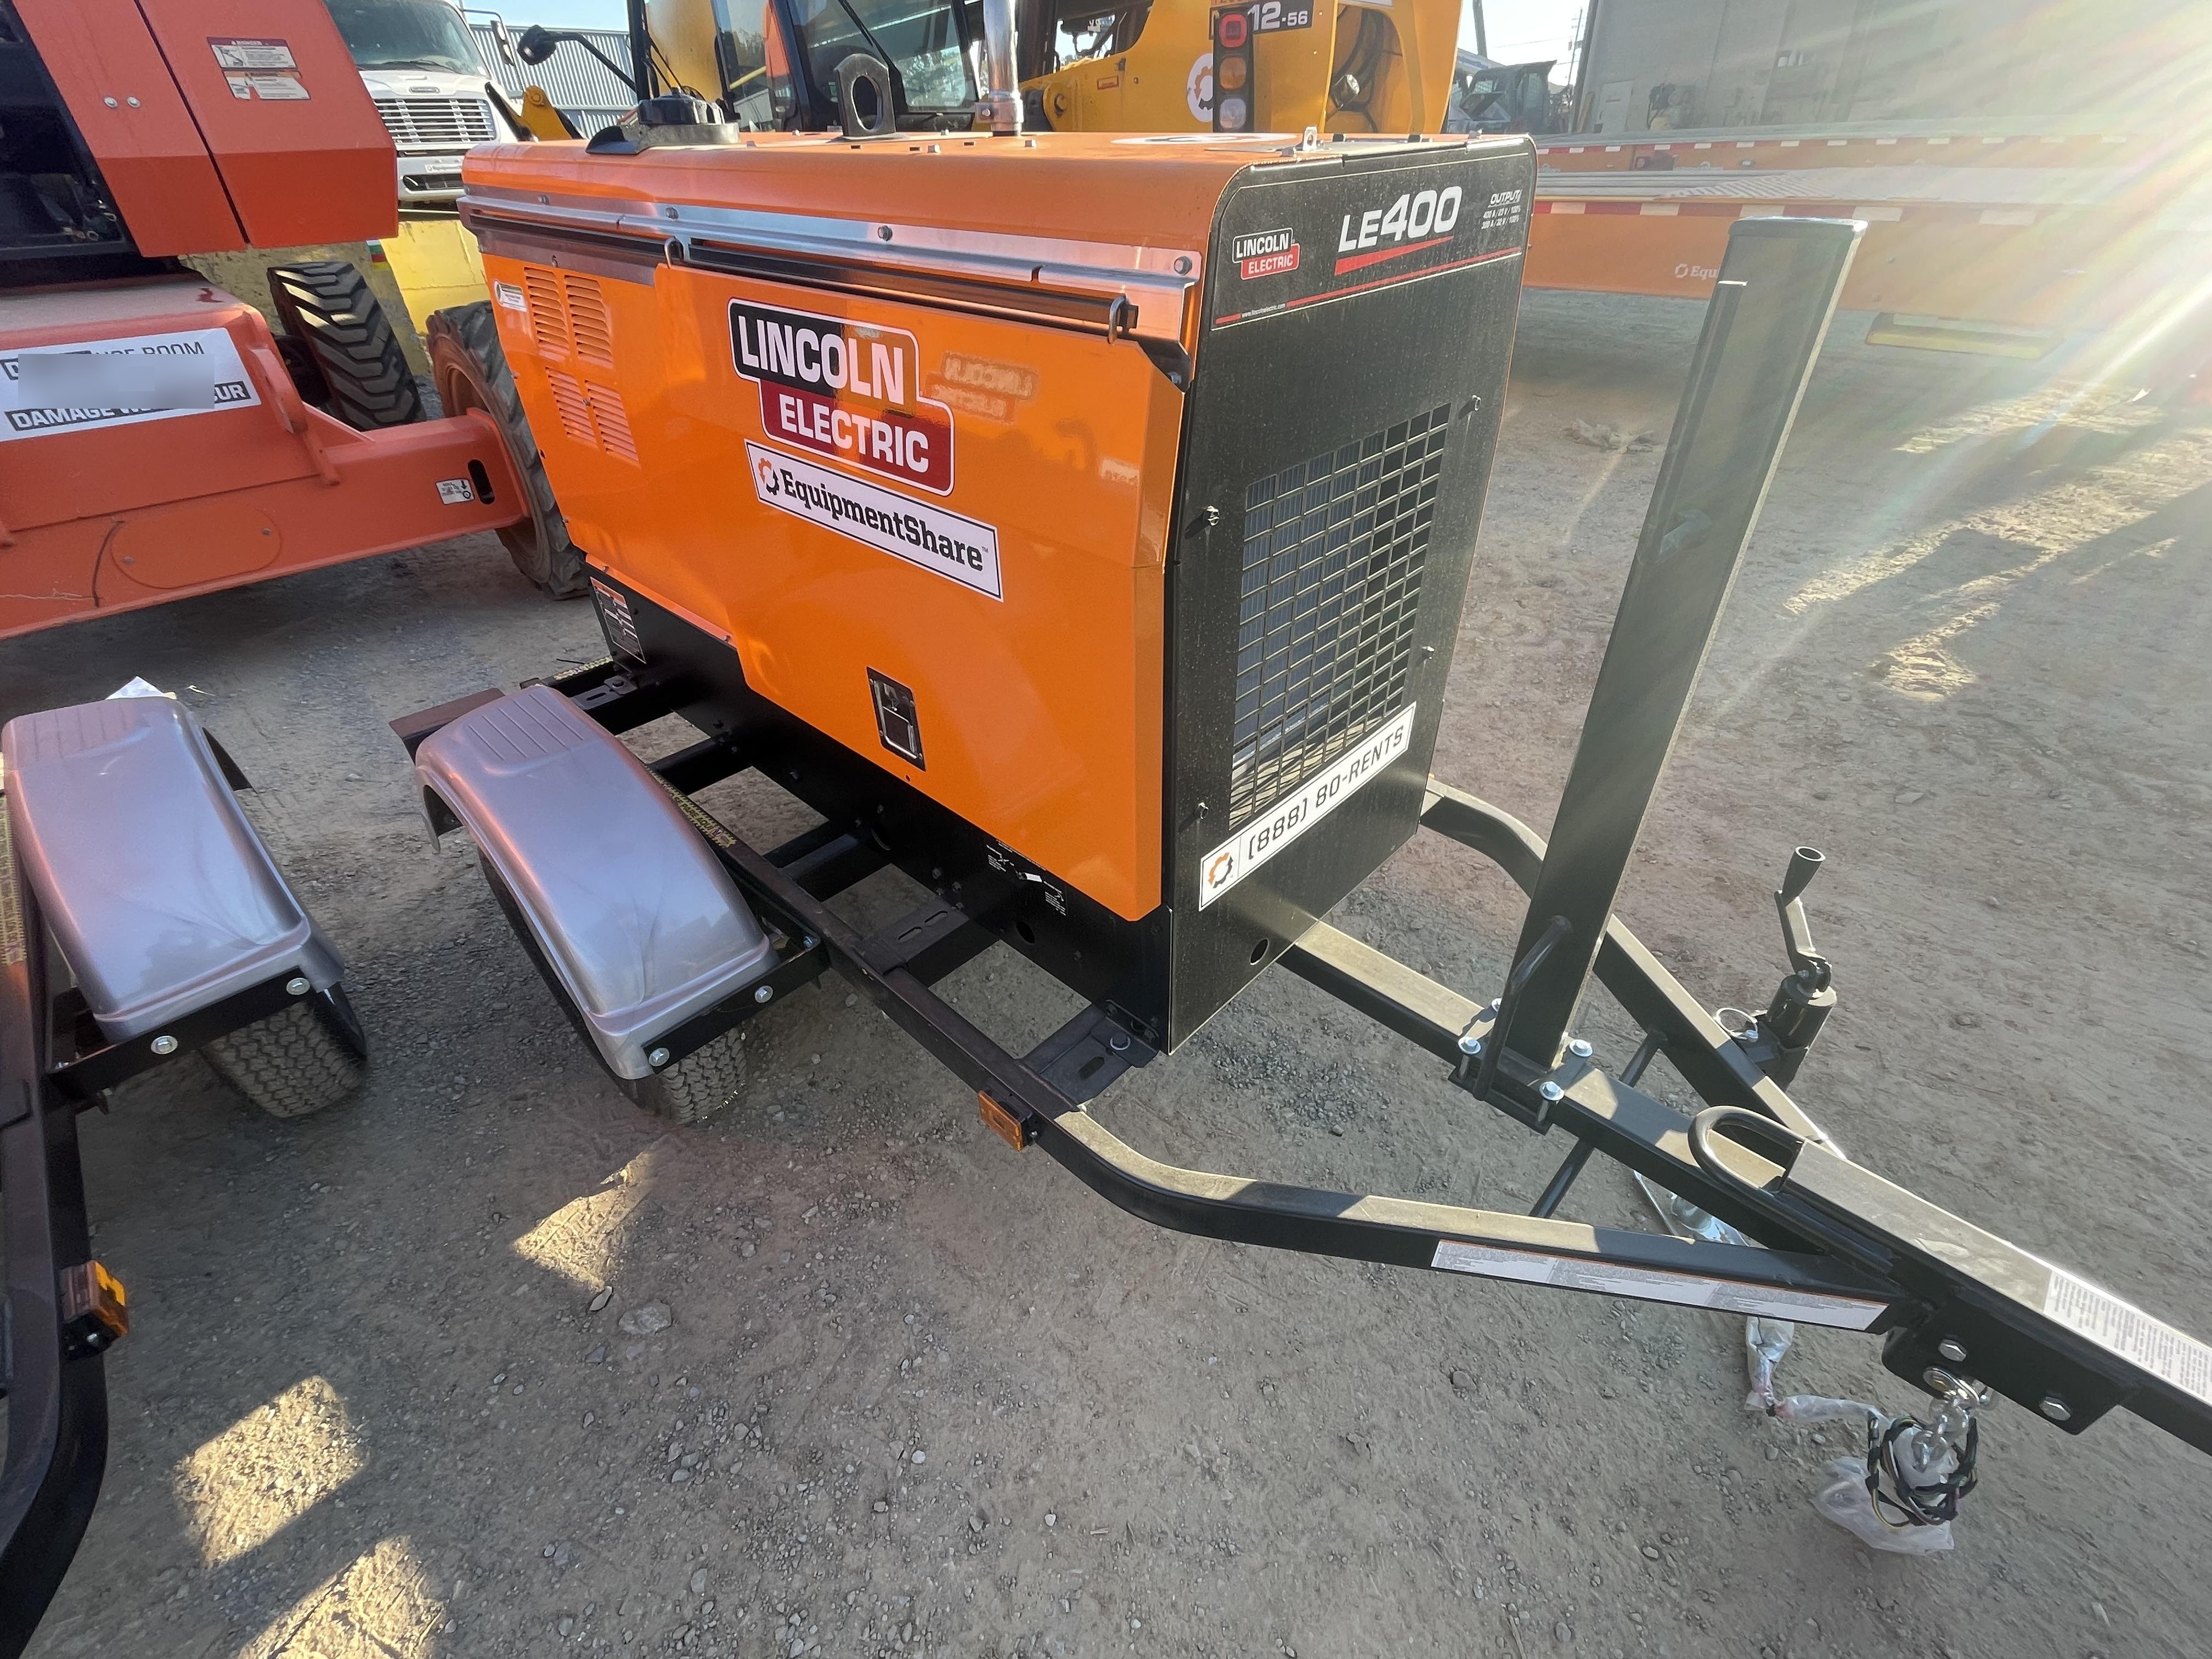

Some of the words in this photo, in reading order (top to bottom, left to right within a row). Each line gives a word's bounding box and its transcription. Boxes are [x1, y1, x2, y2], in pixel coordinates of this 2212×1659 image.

[1338, 185, 1463, 253] LE400
[1489, 189, 1521, 205] OUTPUT
[1235, 233, 1289, 259] LINCOLN
[1248, 253, 1294, 275] ELECTRIC
[738, 315, 905, 405] LINCOLN
[778, 393, 929, 473] ELECTRIC
[779, 468, 983, 572] EquipmentShare
[1248, 798, 1308, 860] (888)
[1316, 724, 1404, 809] 80-RENTS
